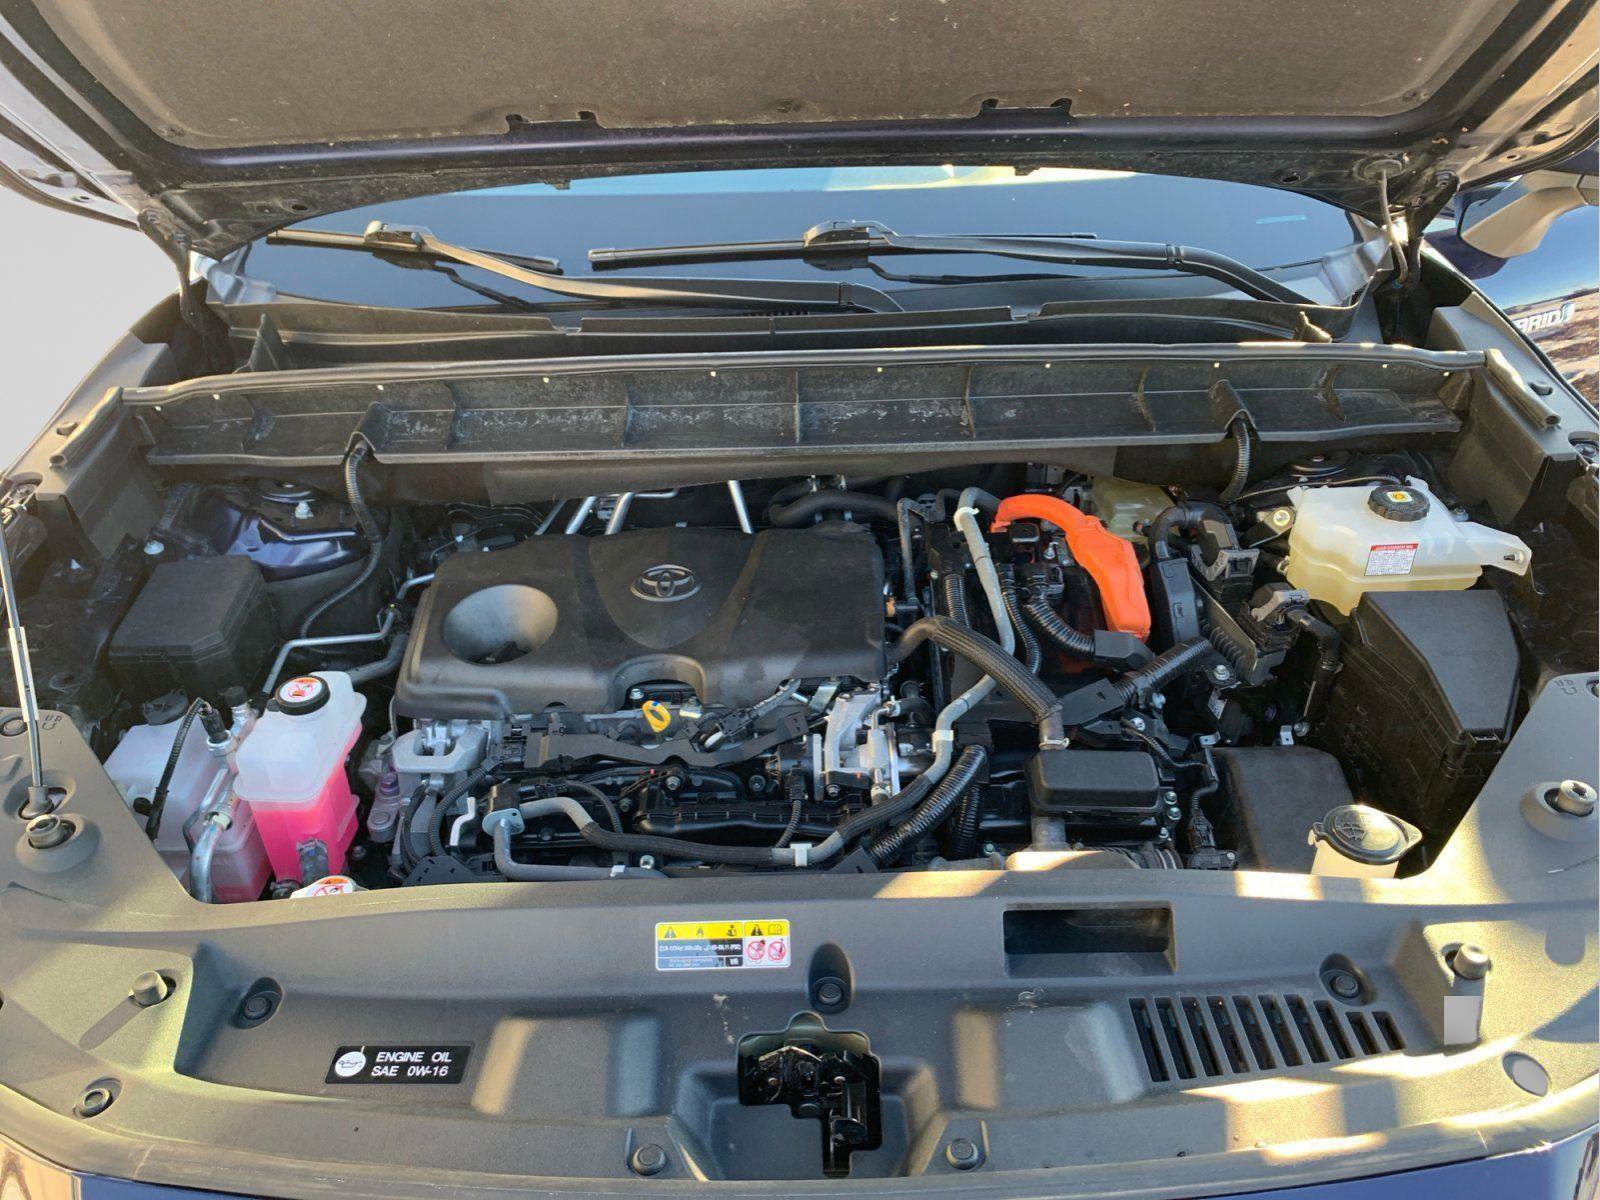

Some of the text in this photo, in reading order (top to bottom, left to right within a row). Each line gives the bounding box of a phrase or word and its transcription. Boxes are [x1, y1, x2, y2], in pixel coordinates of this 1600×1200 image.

[376, 1051, 452, 1063] ENGINE OIL
[371, 1065, 449, 1077] SAE 0W-16
